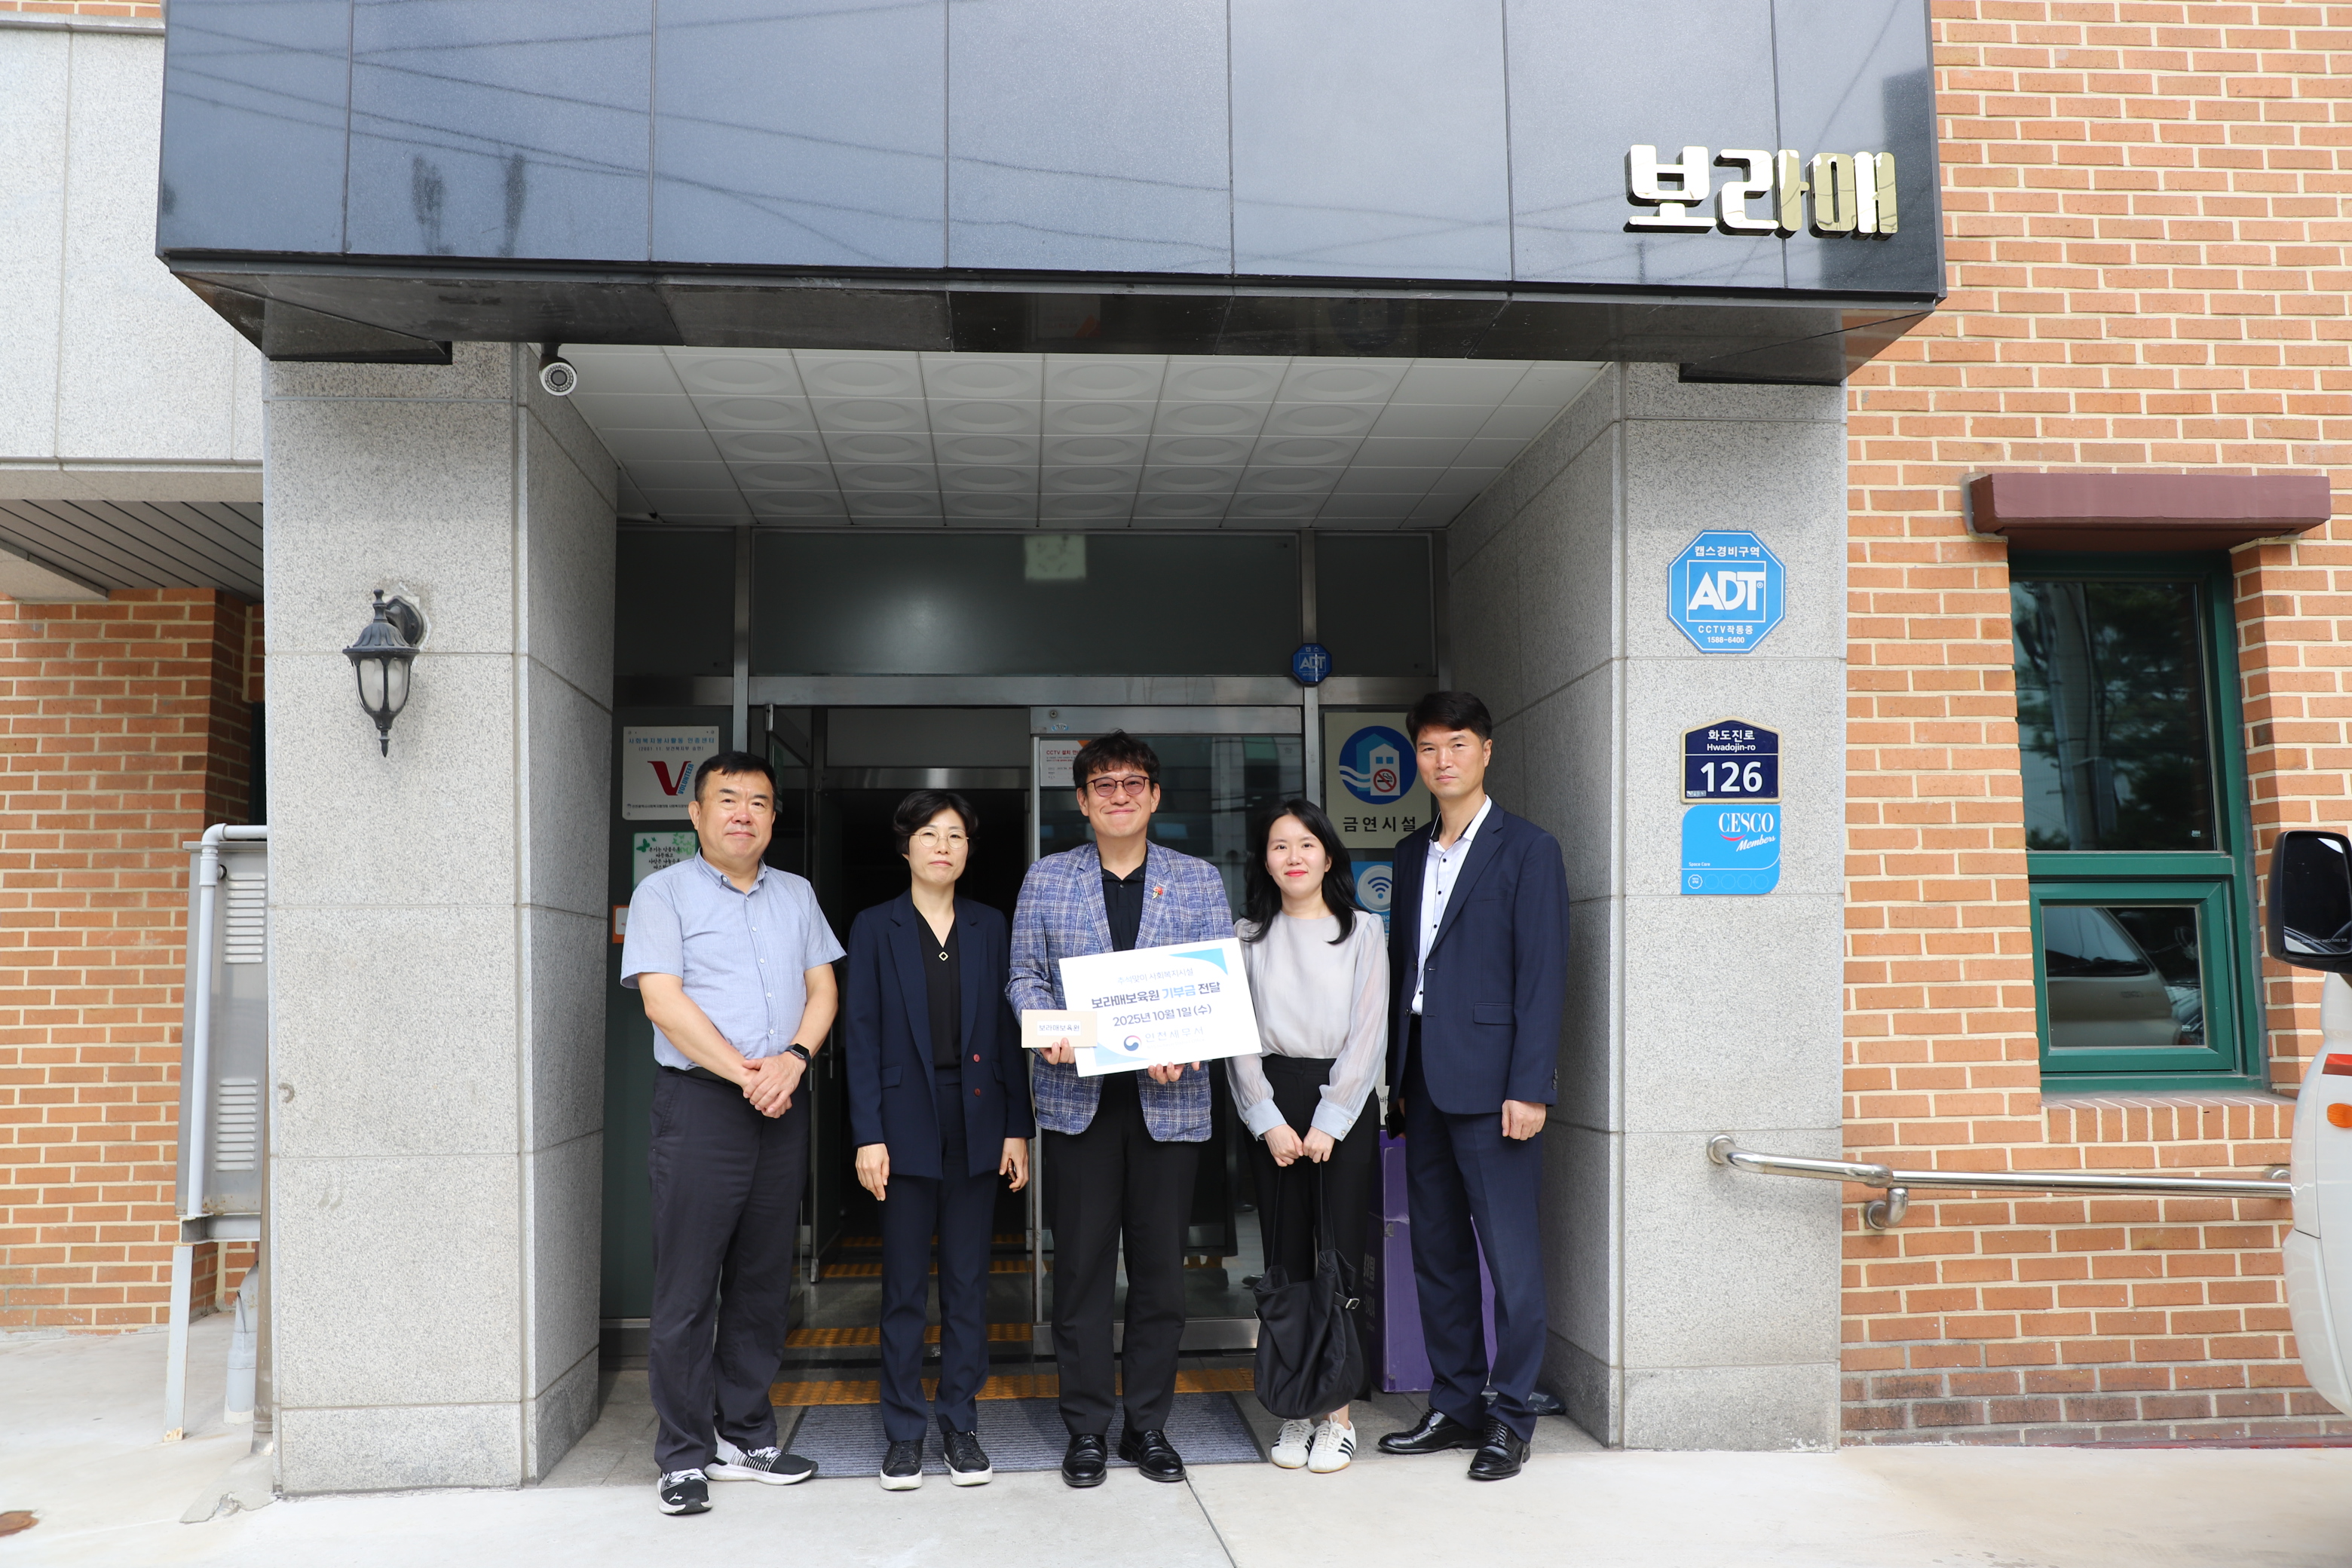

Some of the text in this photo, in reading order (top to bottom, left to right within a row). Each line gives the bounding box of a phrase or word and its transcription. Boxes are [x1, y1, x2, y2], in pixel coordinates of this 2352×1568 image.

[1624, 145, 1898, 240] 보라매
[1695, 546, 1759, 557] 캡스경비구역
[1688, 571, 1765, 611] ADT
[1299, 656, 1325, 669] ADT
[1708, 730, 1755, 743] 화도진로
[1707, 743, 1756, 752] Hwadojin-ro
[677, 763, 694, 795] VOLUNTEER
[1701, 761, 1762, 792] 126
[1343, 816, 1416, 832] 금연시설
[1718, 813, 1774, 832] CESCO
[1736, 835, 1776, 852] Members
[1117, 967, 1193, 985] 추석맞이 사회복지시설
[1092, 982, 1220, 1009] 보라매보육원 기부금 전달
[1113, 1004, 1211, 1027] 2025년 10월 1일 (수)
[1145, 1026, 1203, 1043] 인천세무서
